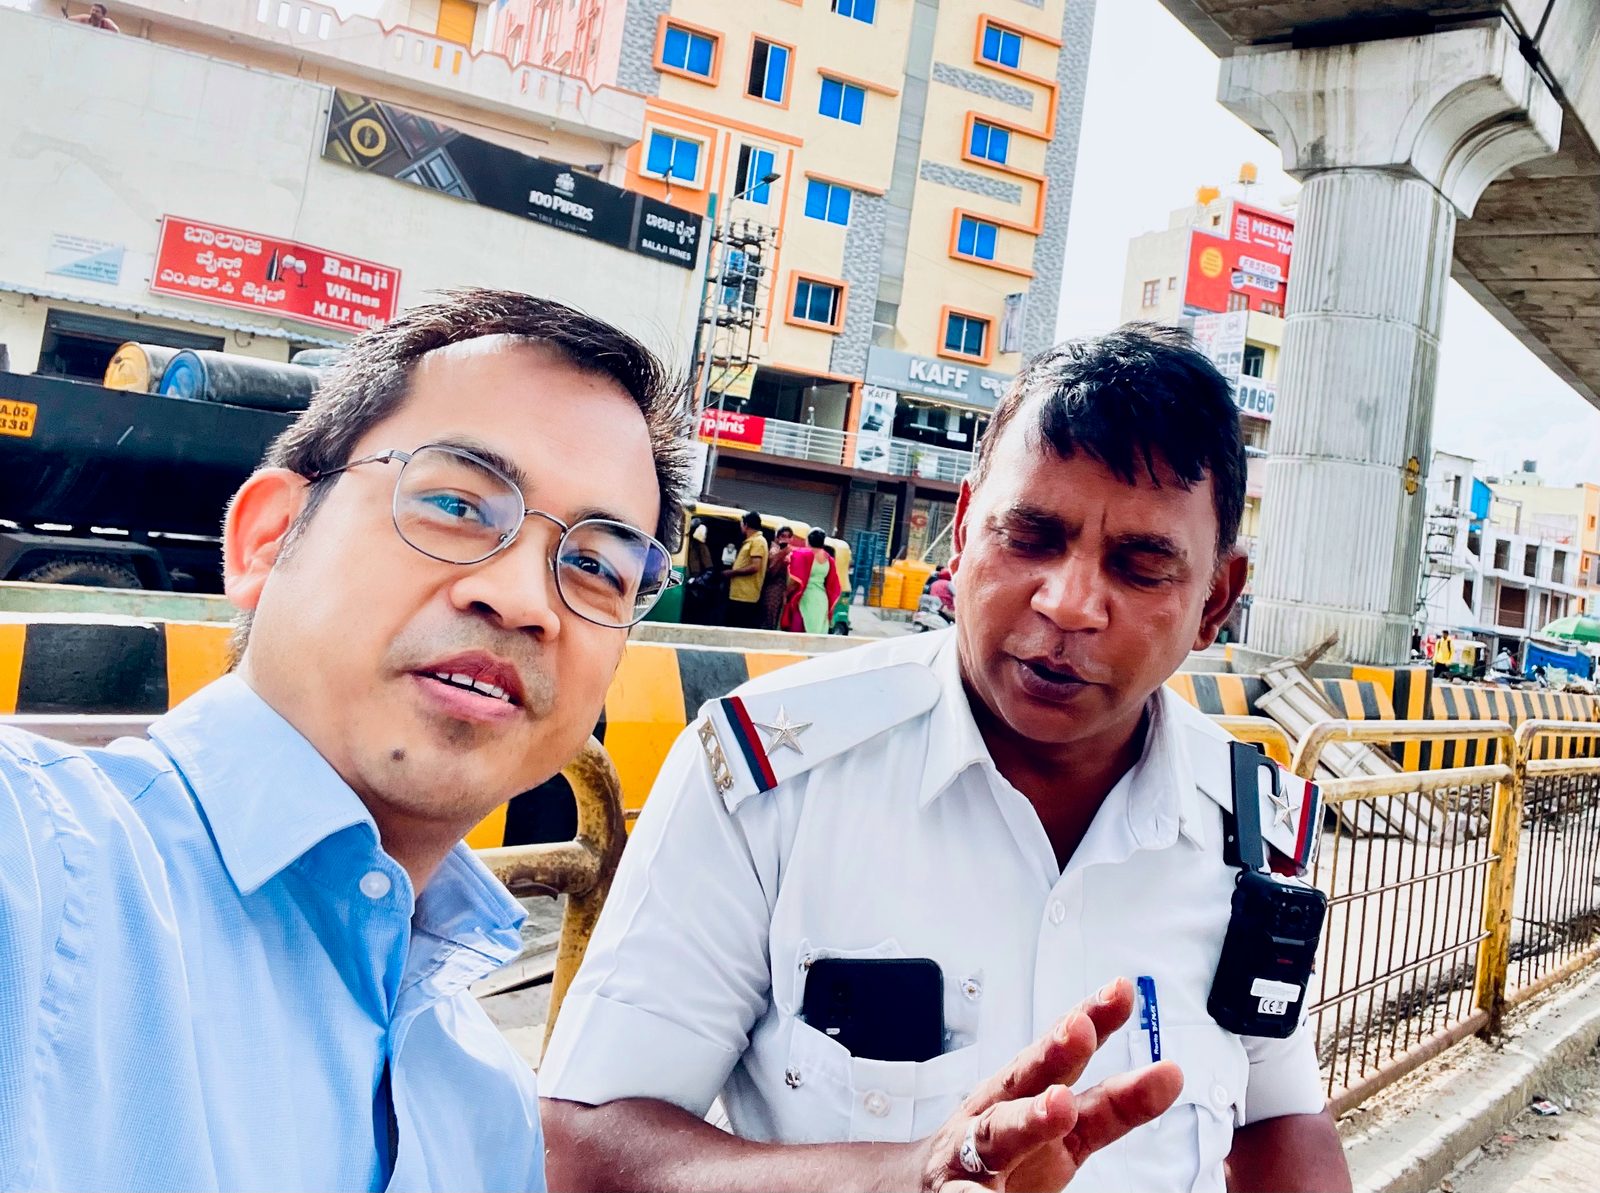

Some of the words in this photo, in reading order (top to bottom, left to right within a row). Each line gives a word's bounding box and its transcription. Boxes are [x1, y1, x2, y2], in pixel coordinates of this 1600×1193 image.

[529, 190, 552, 208] 100
[552, 195, 594, 221] PIPERS
[641, 238, 668, 253] BALAJI
[669, 247, 691, 261] WINES
[322, 256, 388, 291] Balaji
[325, 281, 380, 308] Wines
[909, 359, 970, 389] KAFF
[868, 388, 892, 401] KAFF
